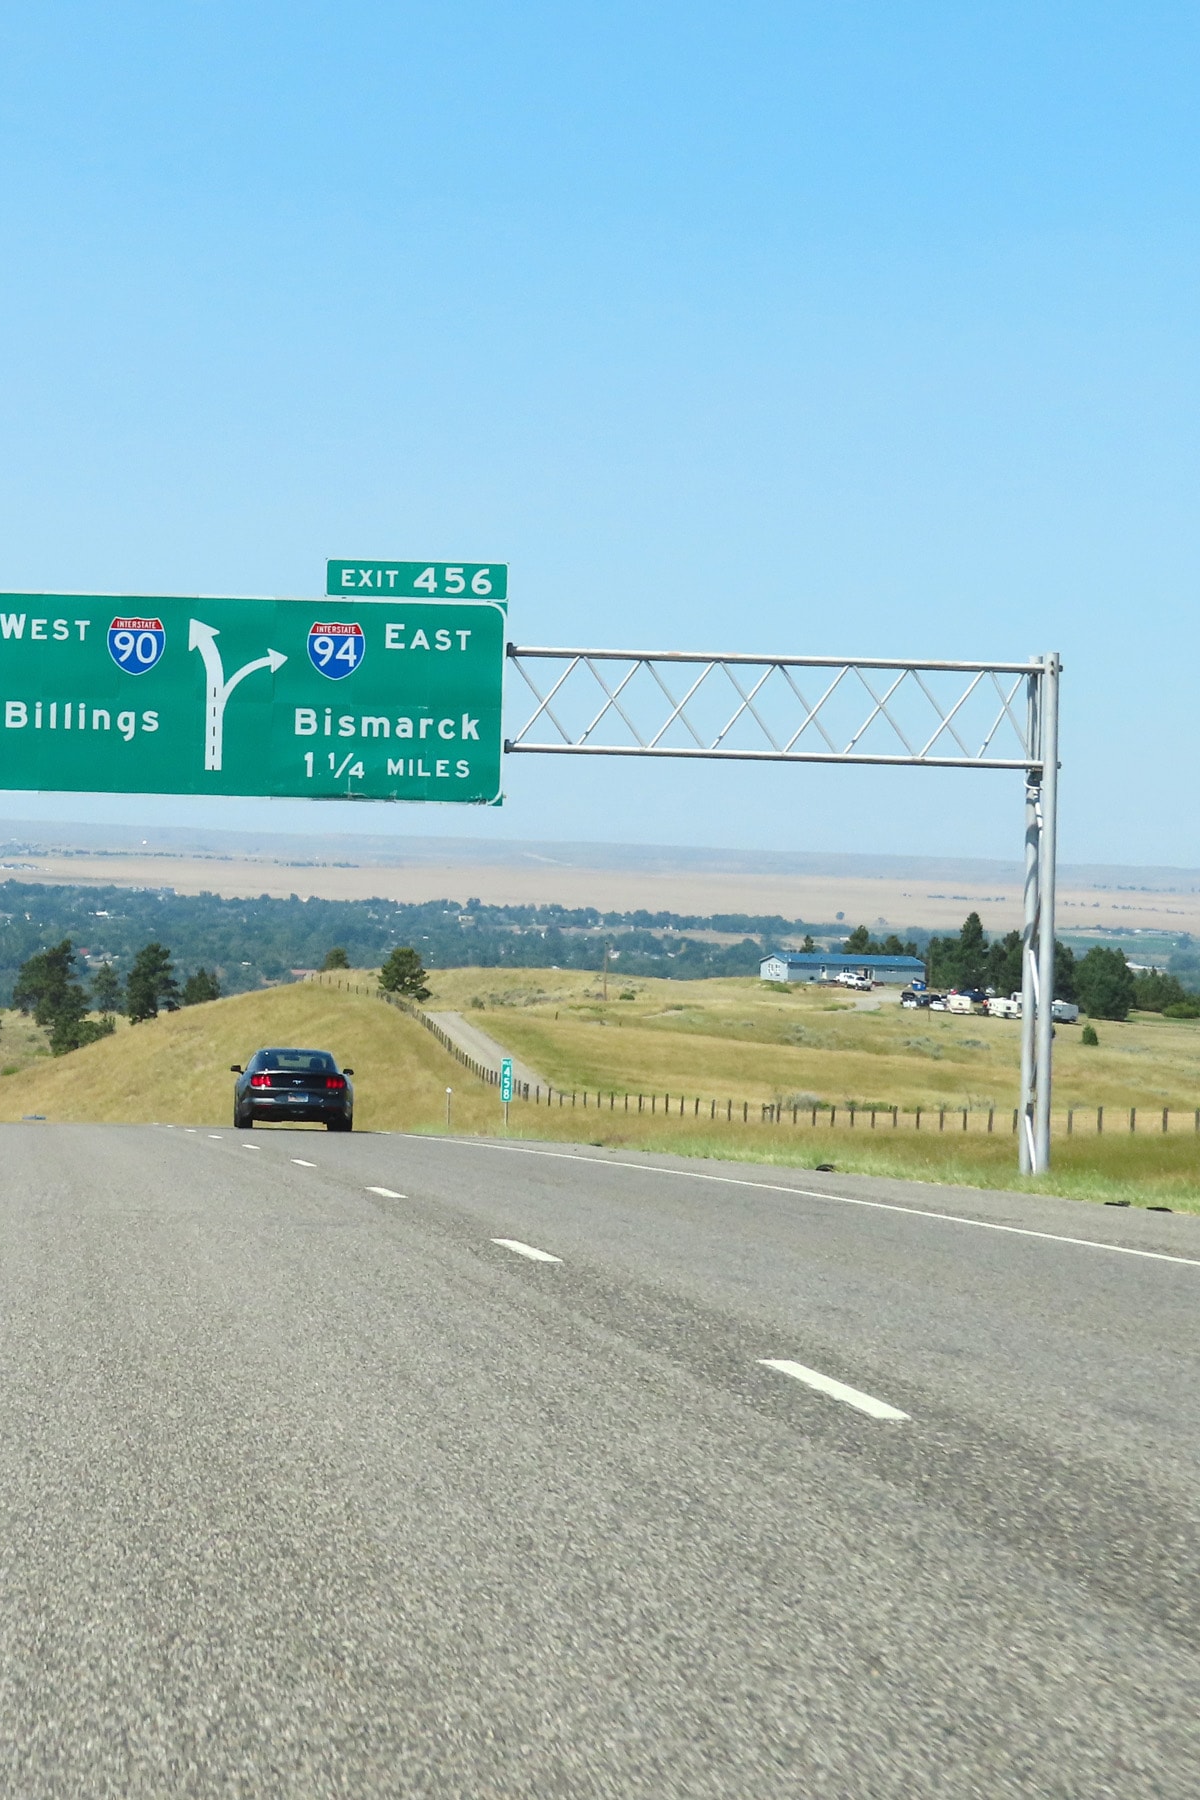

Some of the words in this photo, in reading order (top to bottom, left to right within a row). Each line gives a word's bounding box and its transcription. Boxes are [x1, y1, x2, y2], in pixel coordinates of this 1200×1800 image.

[341, 569, 399, 588] EXIT
[413, 567, 492, 595] 456
[0, 613, 91, 641] WEST
[116, 620, 157, 629] INTERSTATE
[316, 625, 357, 634] INTERSTATE
[384, 623, 472, 651] EAST
[113, 631, 158, 664] 90
[313, 636, 358, 668] 94
[4, 700, 160, 742] Billings
[294, 707, 481, 741] Bismarck
[386, 758, 470, 778] MILES
